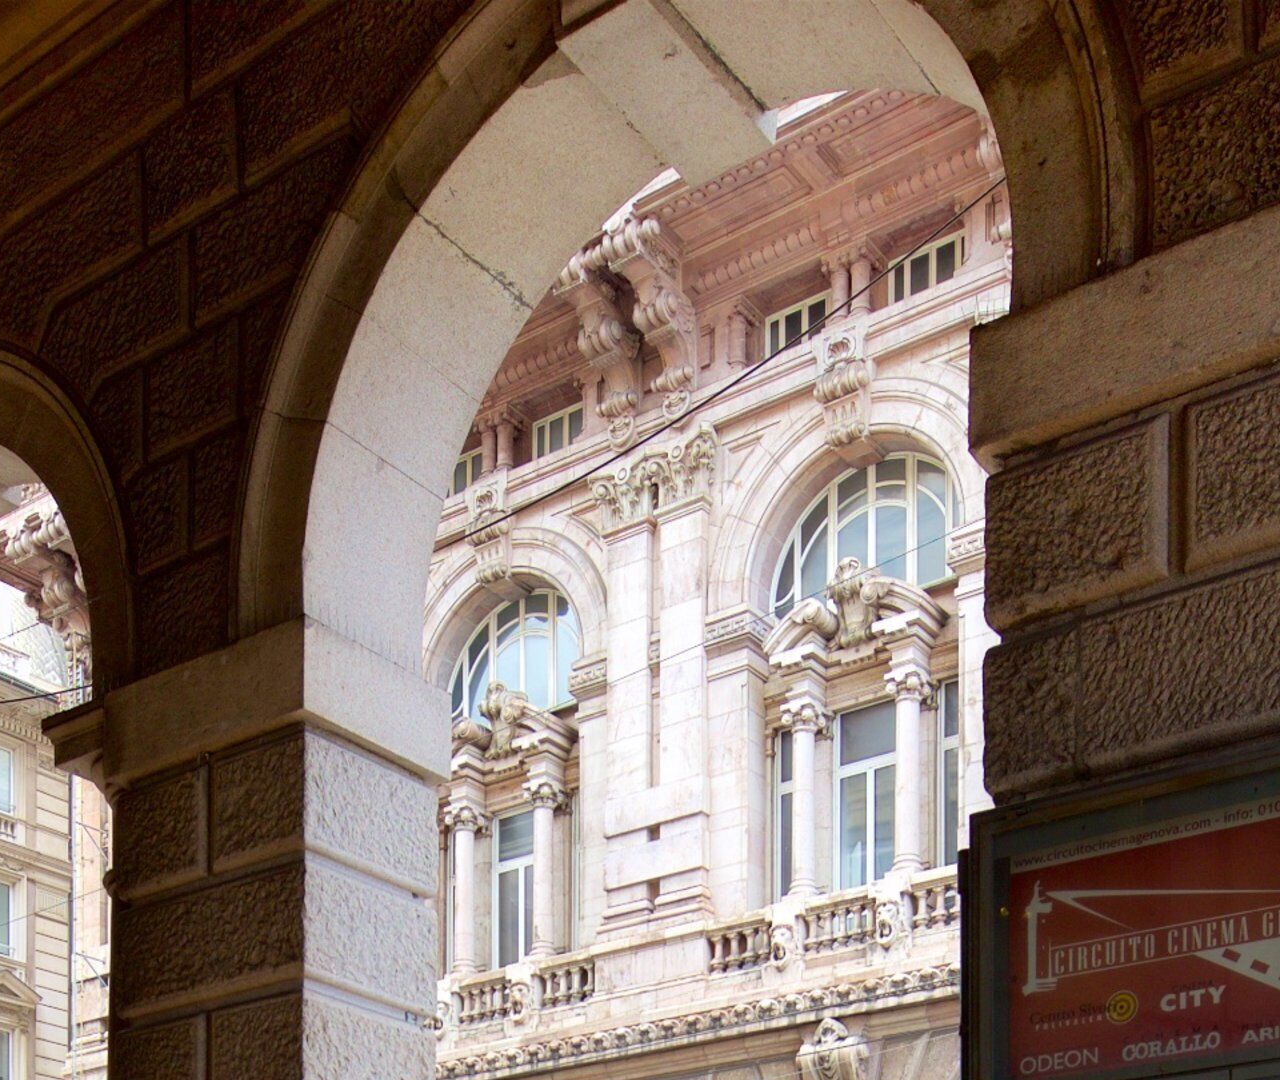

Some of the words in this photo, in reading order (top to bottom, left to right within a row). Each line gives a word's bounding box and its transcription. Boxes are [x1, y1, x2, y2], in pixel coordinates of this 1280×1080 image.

[1054, 932, 1156, 975] CIRCUITO
[1167, 915, 1250, 956] CINEMA
[1160, 984, 1228, 1012] CITY
[1020, 1047, 1100, 1075] ODEON
[1122, 1031, 1221, 1062] CORALLO
